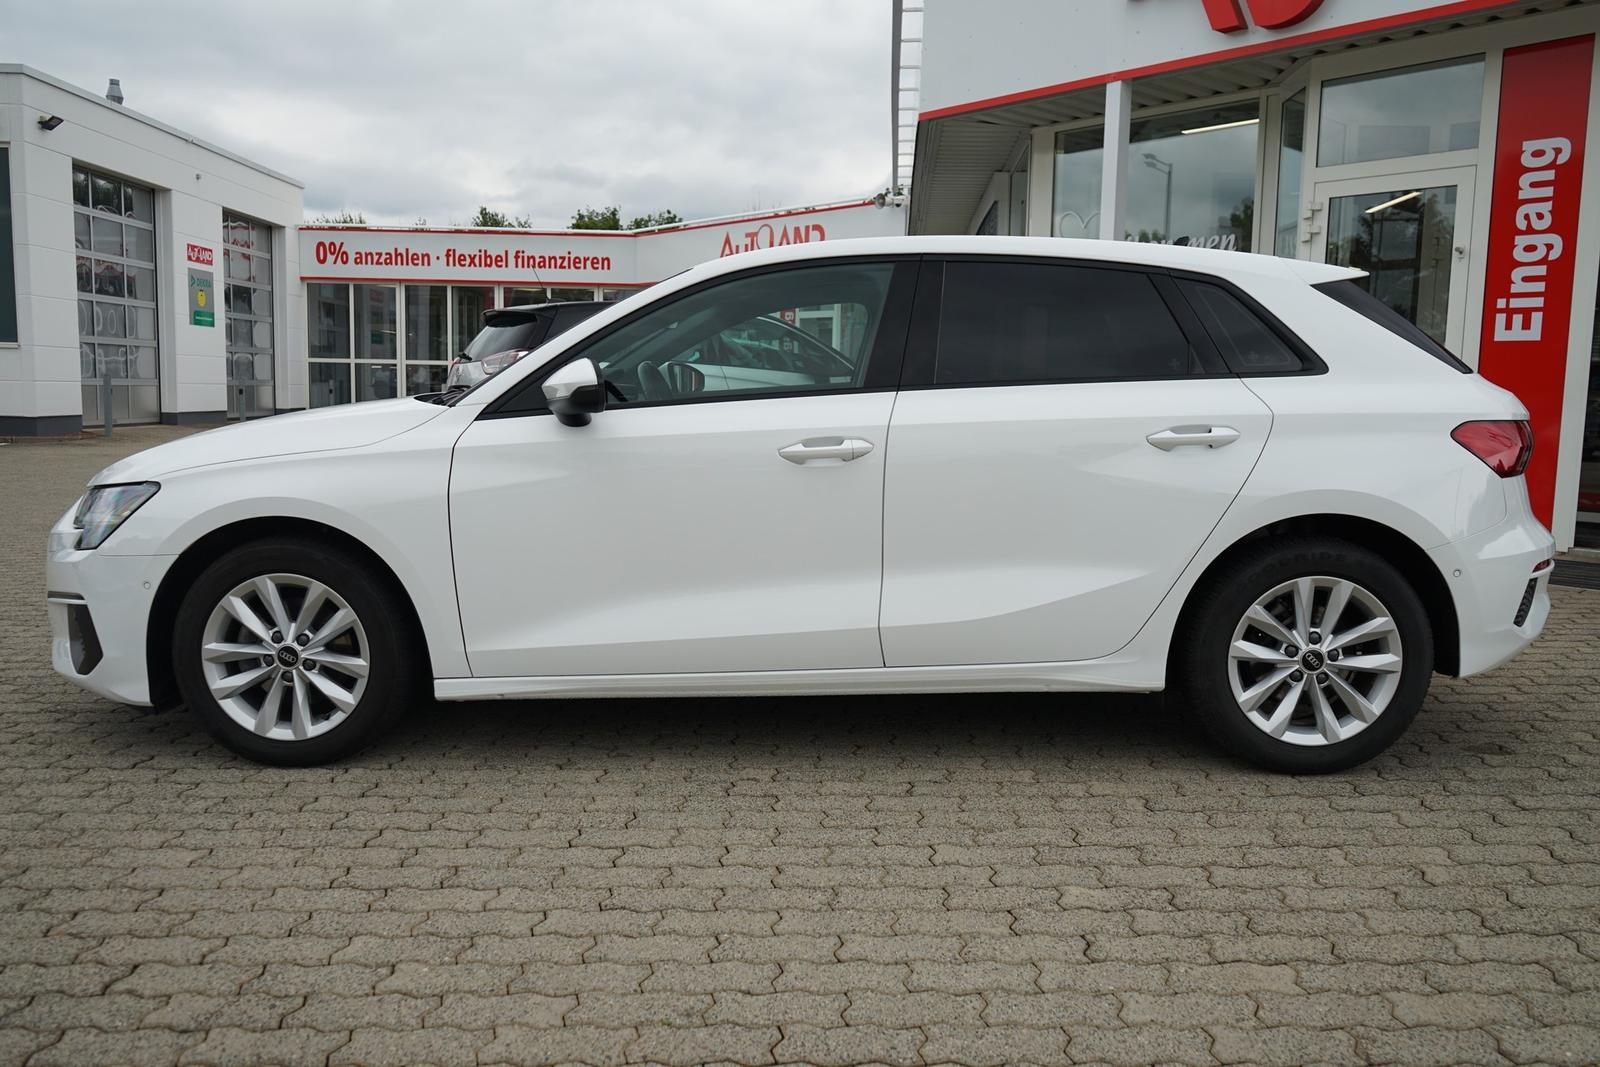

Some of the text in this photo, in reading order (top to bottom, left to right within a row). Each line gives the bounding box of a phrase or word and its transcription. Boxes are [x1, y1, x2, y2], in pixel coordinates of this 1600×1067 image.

[315, 241, 611, 271] 0% anzahlen flexibel finanzieren
[1494, 136, 1572, 342] Eingang
